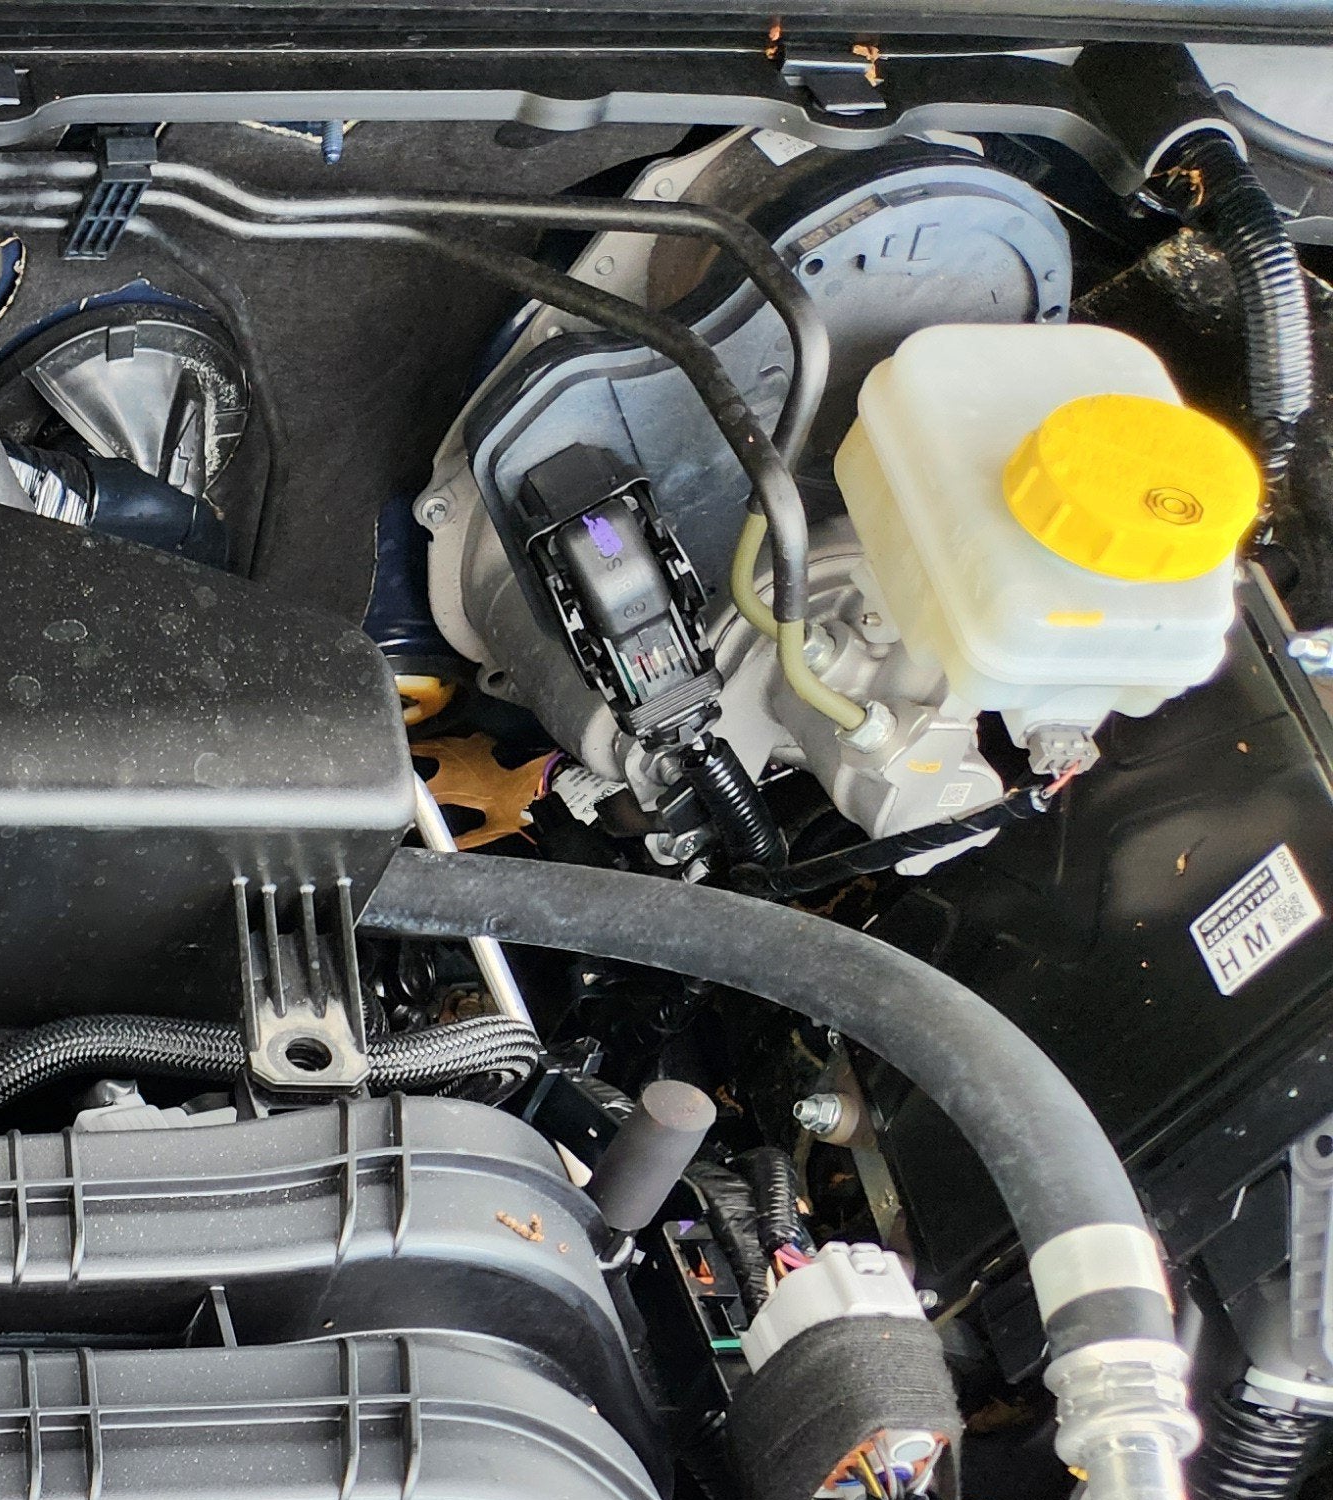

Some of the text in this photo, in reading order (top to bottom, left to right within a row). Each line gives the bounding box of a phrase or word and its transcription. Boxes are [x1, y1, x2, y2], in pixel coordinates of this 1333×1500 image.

[1276, 851, 1299, 884] DENSO
[1216, 946, 1242, 980] H
[1243, 921, 1272, 959] M
